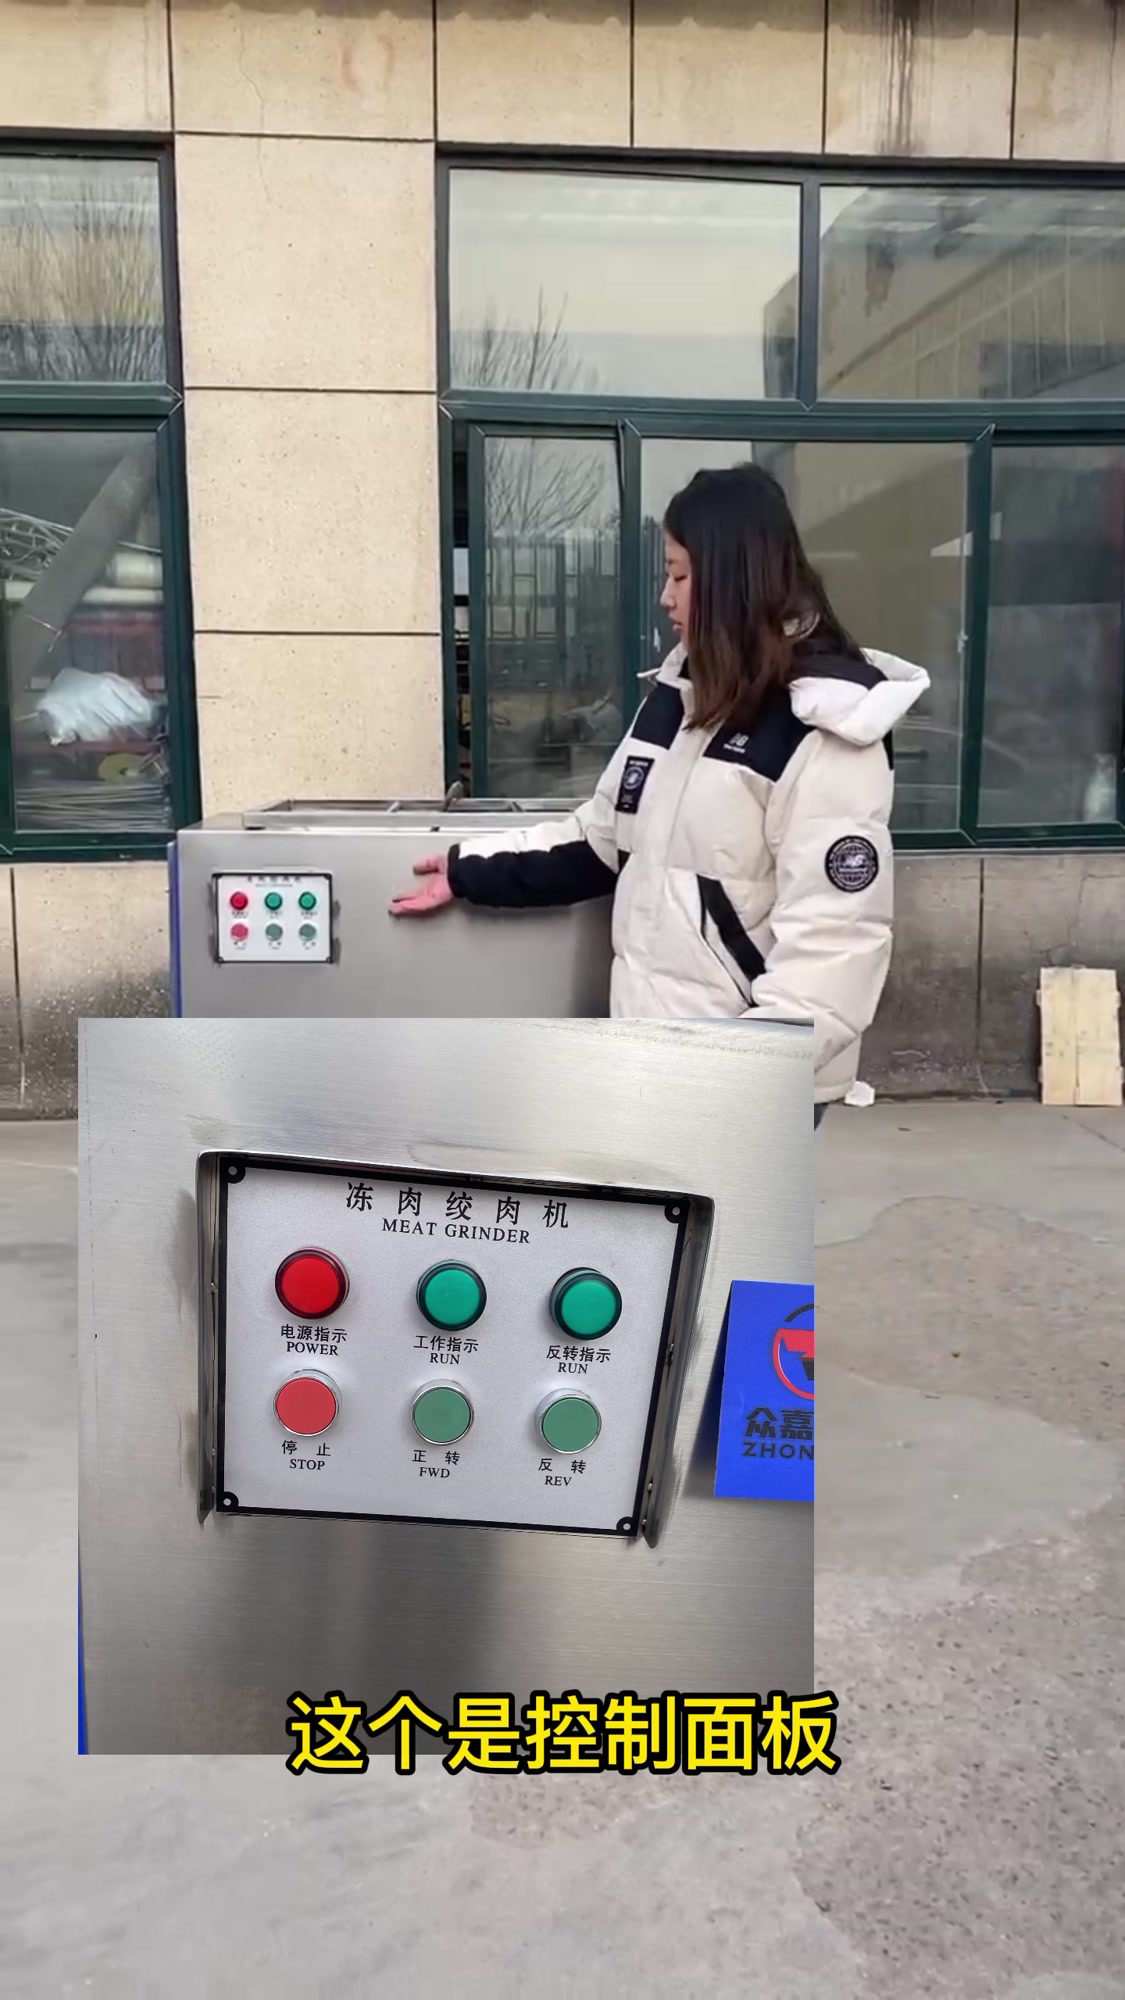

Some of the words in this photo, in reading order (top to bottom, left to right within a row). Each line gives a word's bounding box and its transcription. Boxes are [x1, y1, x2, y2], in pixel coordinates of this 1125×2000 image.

[346, 1182, 569, 1229] 冻肉绞肉机
[382, 1217, 437, 1236] MEAT
[444, 1223, 531, 1244] GRINDER
[281, 1324, 348, 1343] 电源指示
[286, 1341, 339, 1356] POWER
[414, 1335, 479, 1354] 工作指示
[429, 1353, 461, 1365] RUN
[546, 1345, 611, 1364] 反转指示
[558, 1361, 588, 1375] RUN
[745, 1407, 814, 1440] 众嘉
[742, 1441, 814, 1460] ZHON
[289, 1458, 326, 1471] STOP
[419, 1466, 451, 1479] FWD
[544, 1475, 573, 1487] REV
